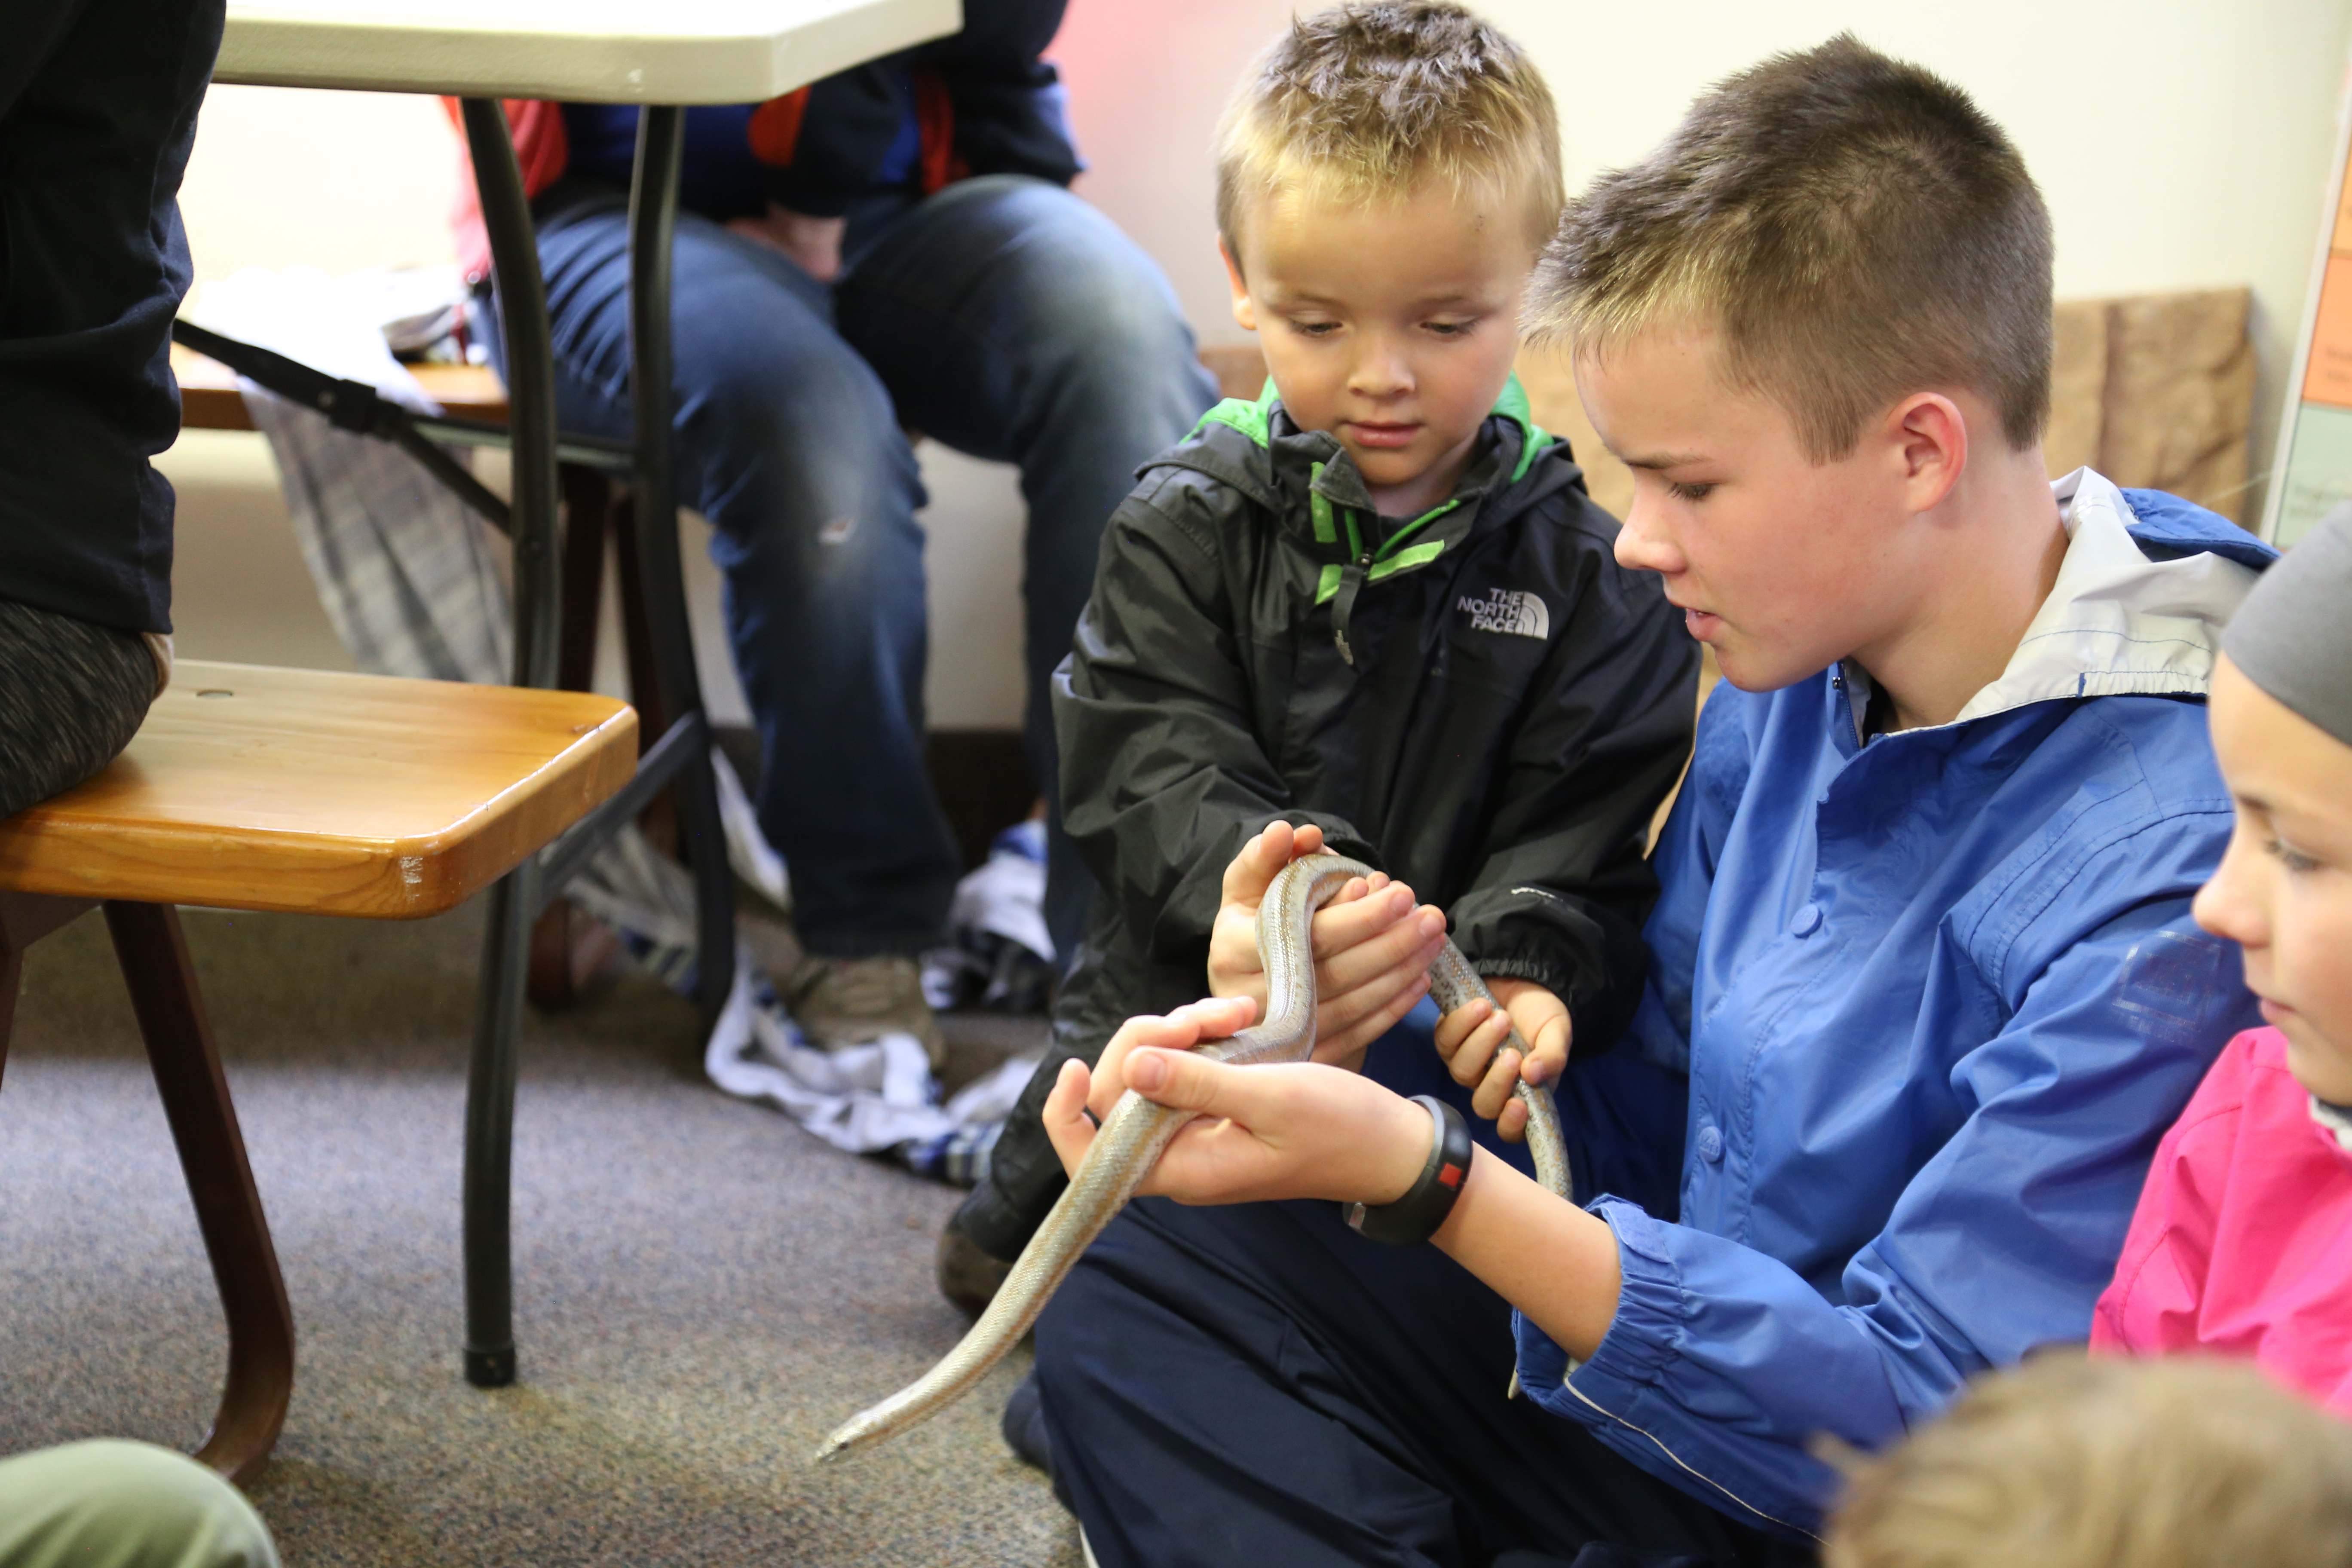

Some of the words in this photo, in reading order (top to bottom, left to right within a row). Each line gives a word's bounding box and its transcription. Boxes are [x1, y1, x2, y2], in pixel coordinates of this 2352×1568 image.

[1490, 588, 1523, 605] THE
[1457, 596, 1521, 619] NORTH
[1471, 614, 1516, 632] FACE
